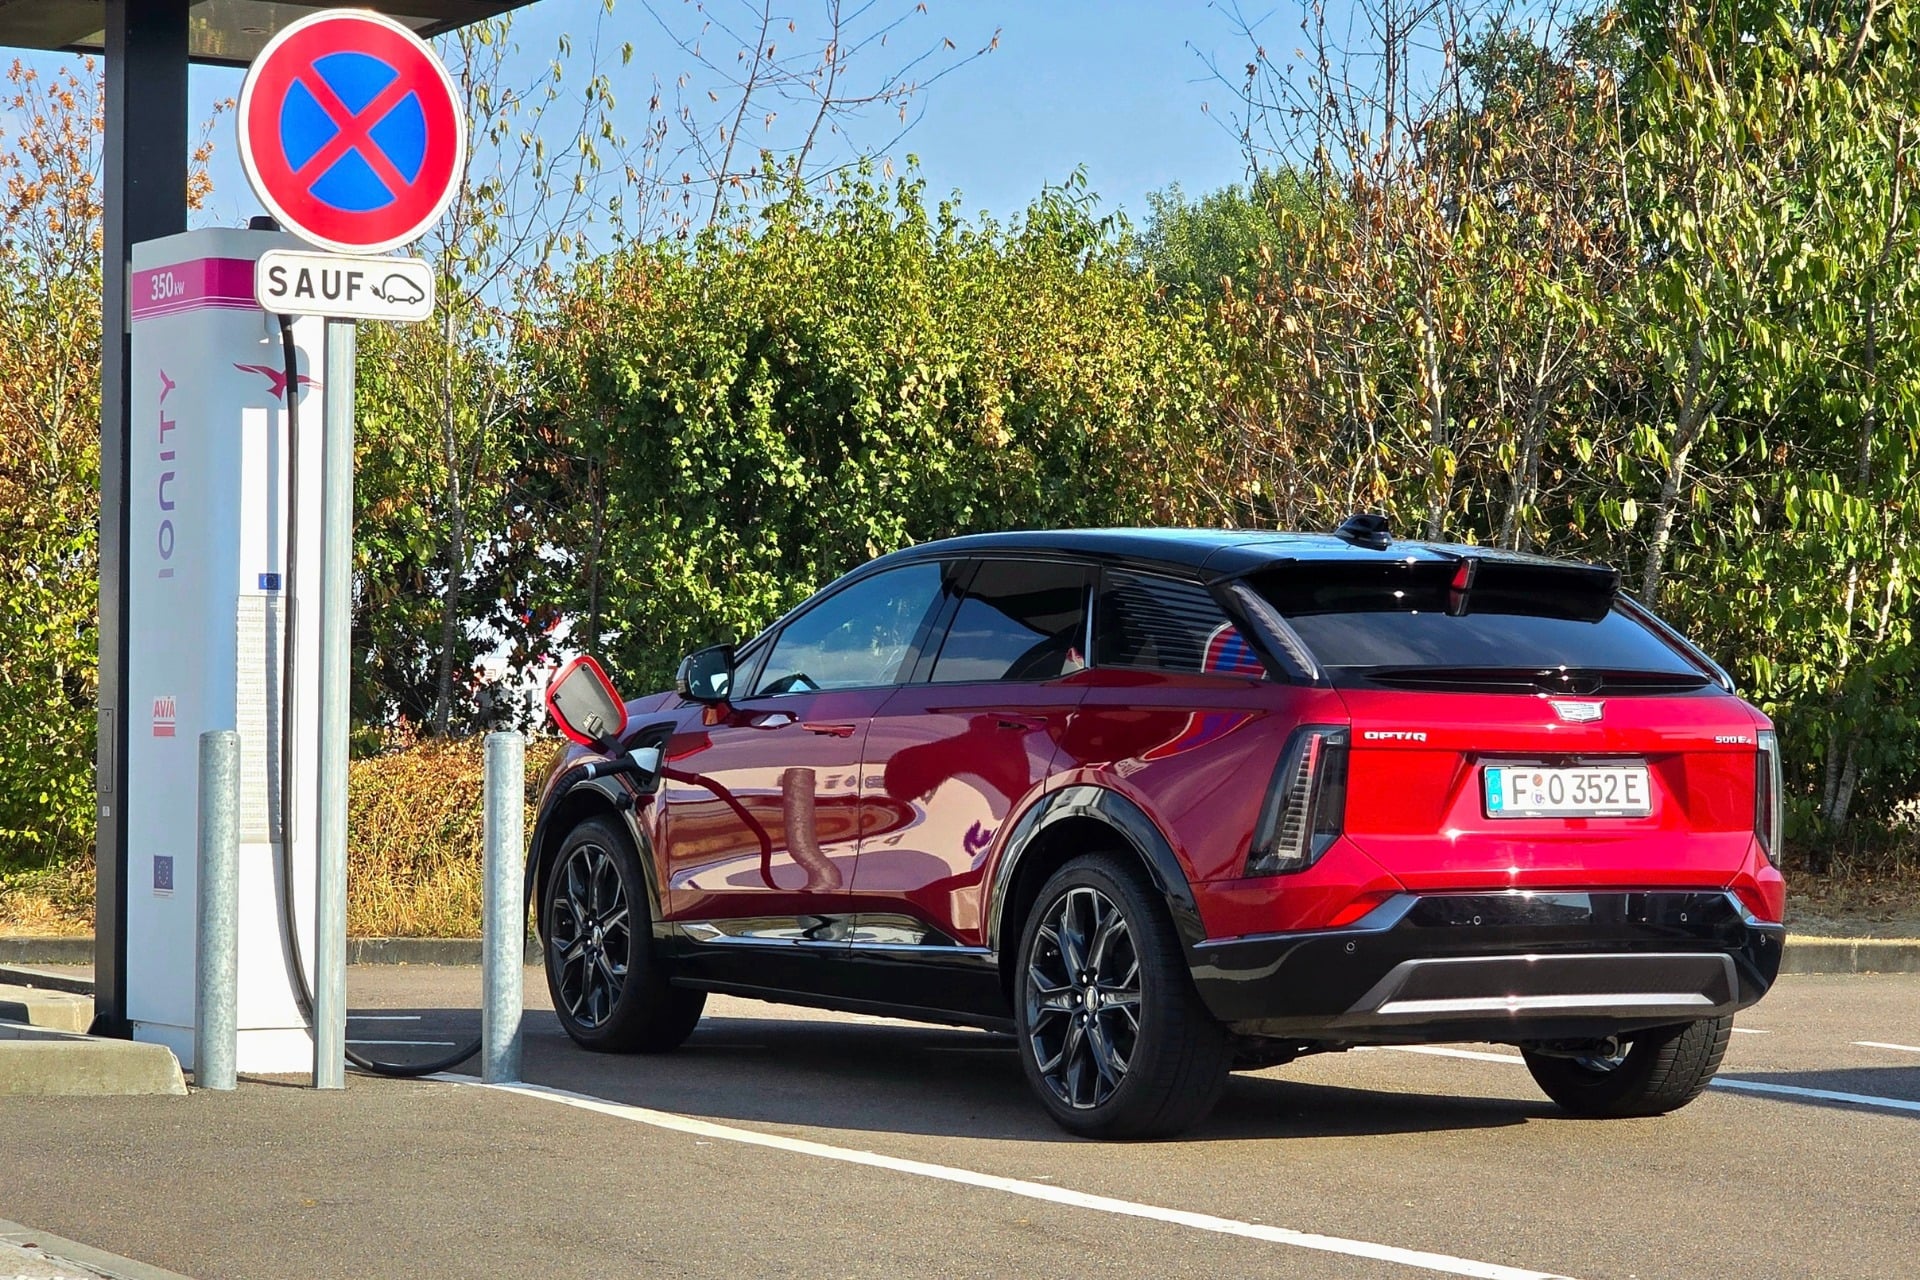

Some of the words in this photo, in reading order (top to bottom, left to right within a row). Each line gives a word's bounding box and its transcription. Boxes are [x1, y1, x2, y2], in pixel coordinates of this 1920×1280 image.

[268, 265, 364, 301] SAUF
[153, 699, 175, 718] AVIA
[1512, 774, 1528, 805] F
